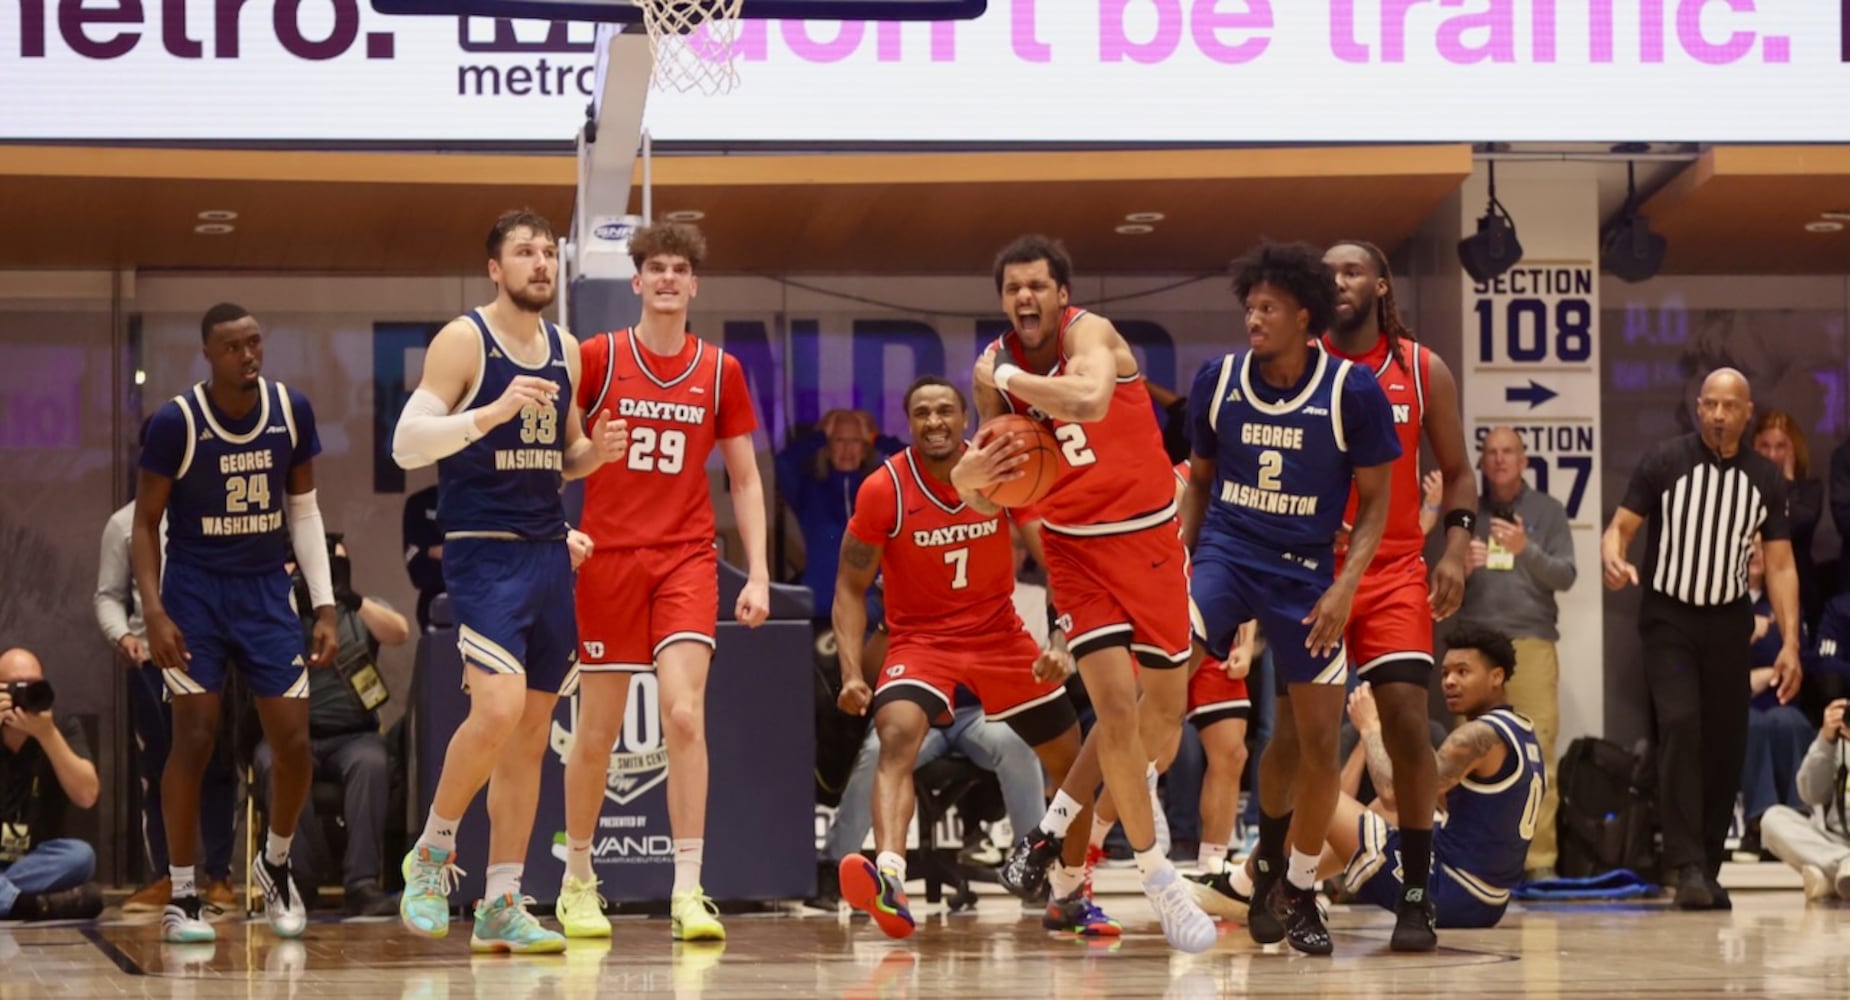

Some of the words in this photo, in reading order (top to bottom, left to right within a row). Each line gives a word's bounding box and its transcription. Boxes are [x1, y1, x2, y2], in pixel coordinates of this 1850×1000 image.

[20, 0, 395, 60] etro.
[1099, 0, 1274, 64] be
[1474, 298, 1591, 363] 108
[520, 403, 557, 444] 33
[619, 398, 706, 425] DAYTON
[627, 426, 686, 474] 29
[1055, 422, 1097, 467] 2
[1241, 422, 1303, 450] GEORGE
[1475, 426, 1592, 452] STION
[220, 449, 273, 474] GEORGE
[494, 449, 563, 471] WASHINGT
[1258, 450, 1283, 490] 2
[226, 473, 271, 513] 24
[1220, 479, 1319, 516] WASHINGTON
[201, 510, 282, 535] WASHINGT
[913, 518, 999, 547] DAYTON
[944, 547, 968, 590] 7
[646, 750, 668, 767] CENT
[591, 836, 674, 857] VAND
